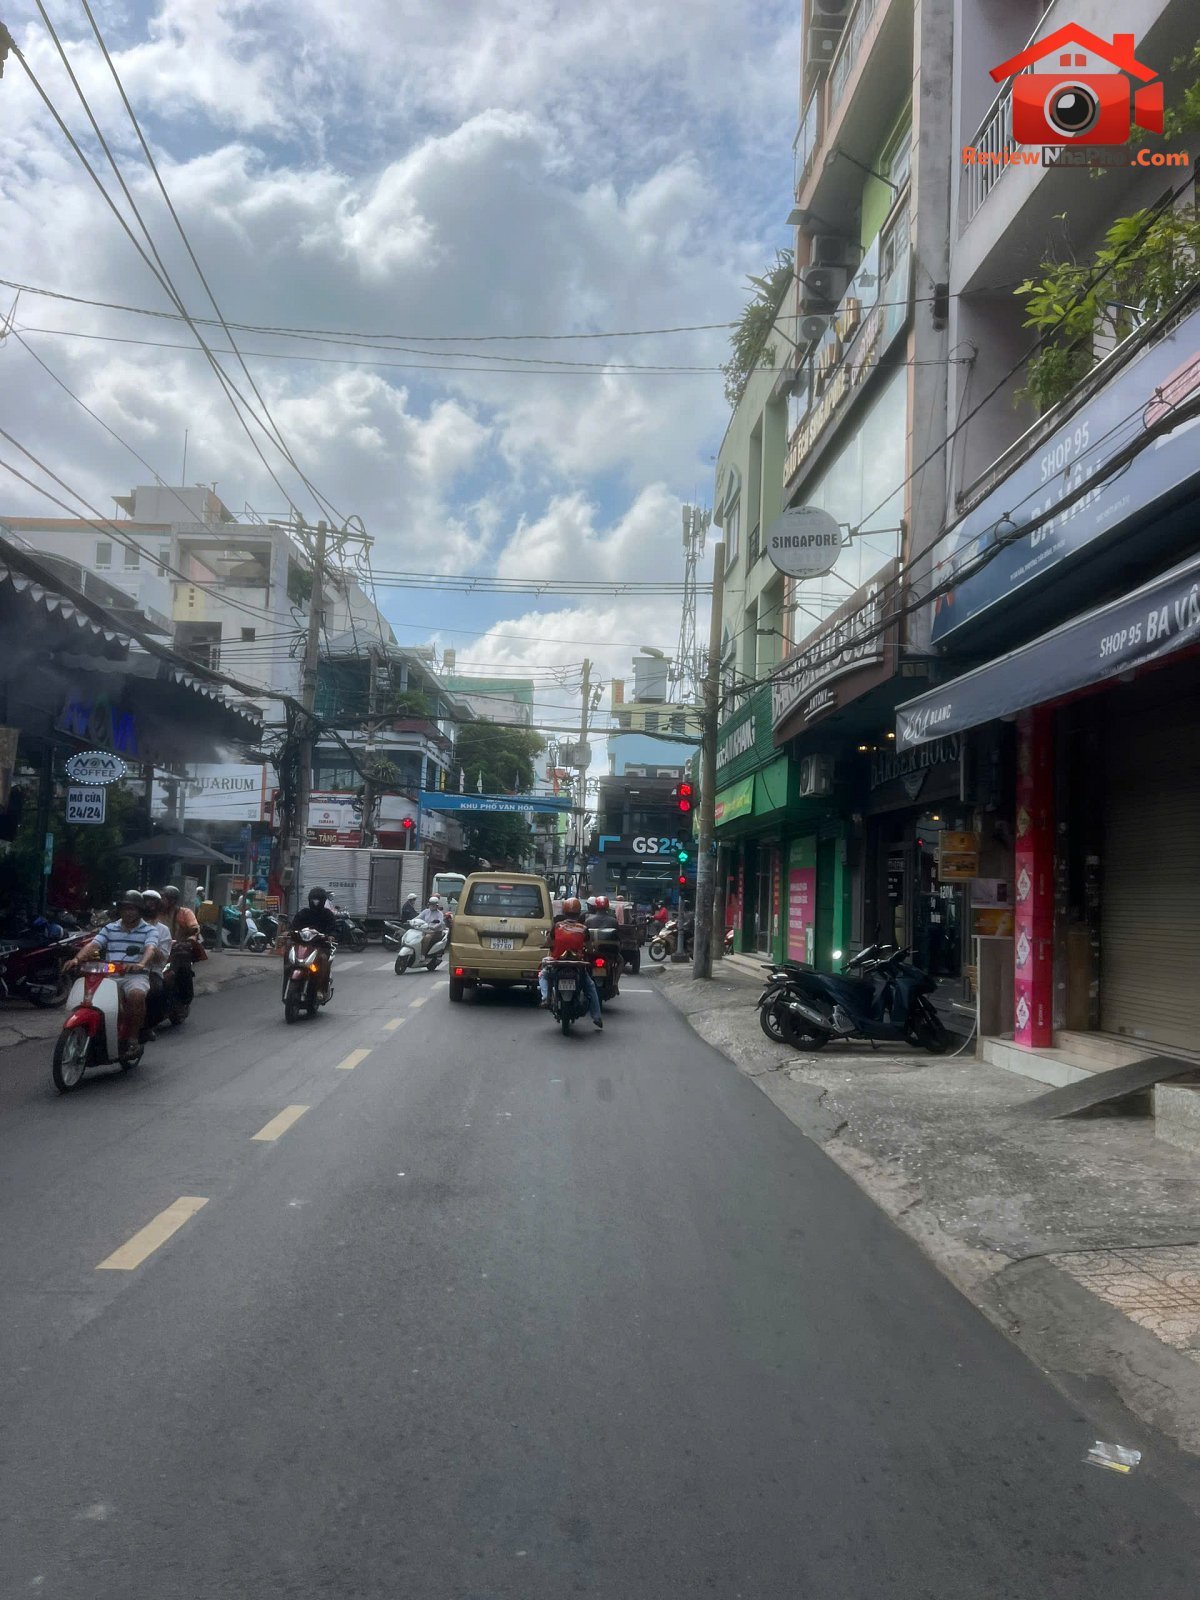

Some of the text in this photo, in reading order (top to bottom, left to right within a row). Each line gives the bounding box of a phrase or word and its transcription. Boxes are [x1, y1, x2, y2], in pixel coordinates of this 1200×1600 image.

[1041, 421, 1090, 482] SHOP 95
[771, 533, 838, 549] SINGAPORE
[1099, 629, 1128, 658] SHOP
[1128, 622, 1143, 646] 95
[1146, 605, 1171, 643] BA
[930, 704, 952, 726] BLANC
[73, 768, 116, 778] COFFEE
[69, 806, 101, 818] 24/24
[480, 802, 497, 810] PHỐ
